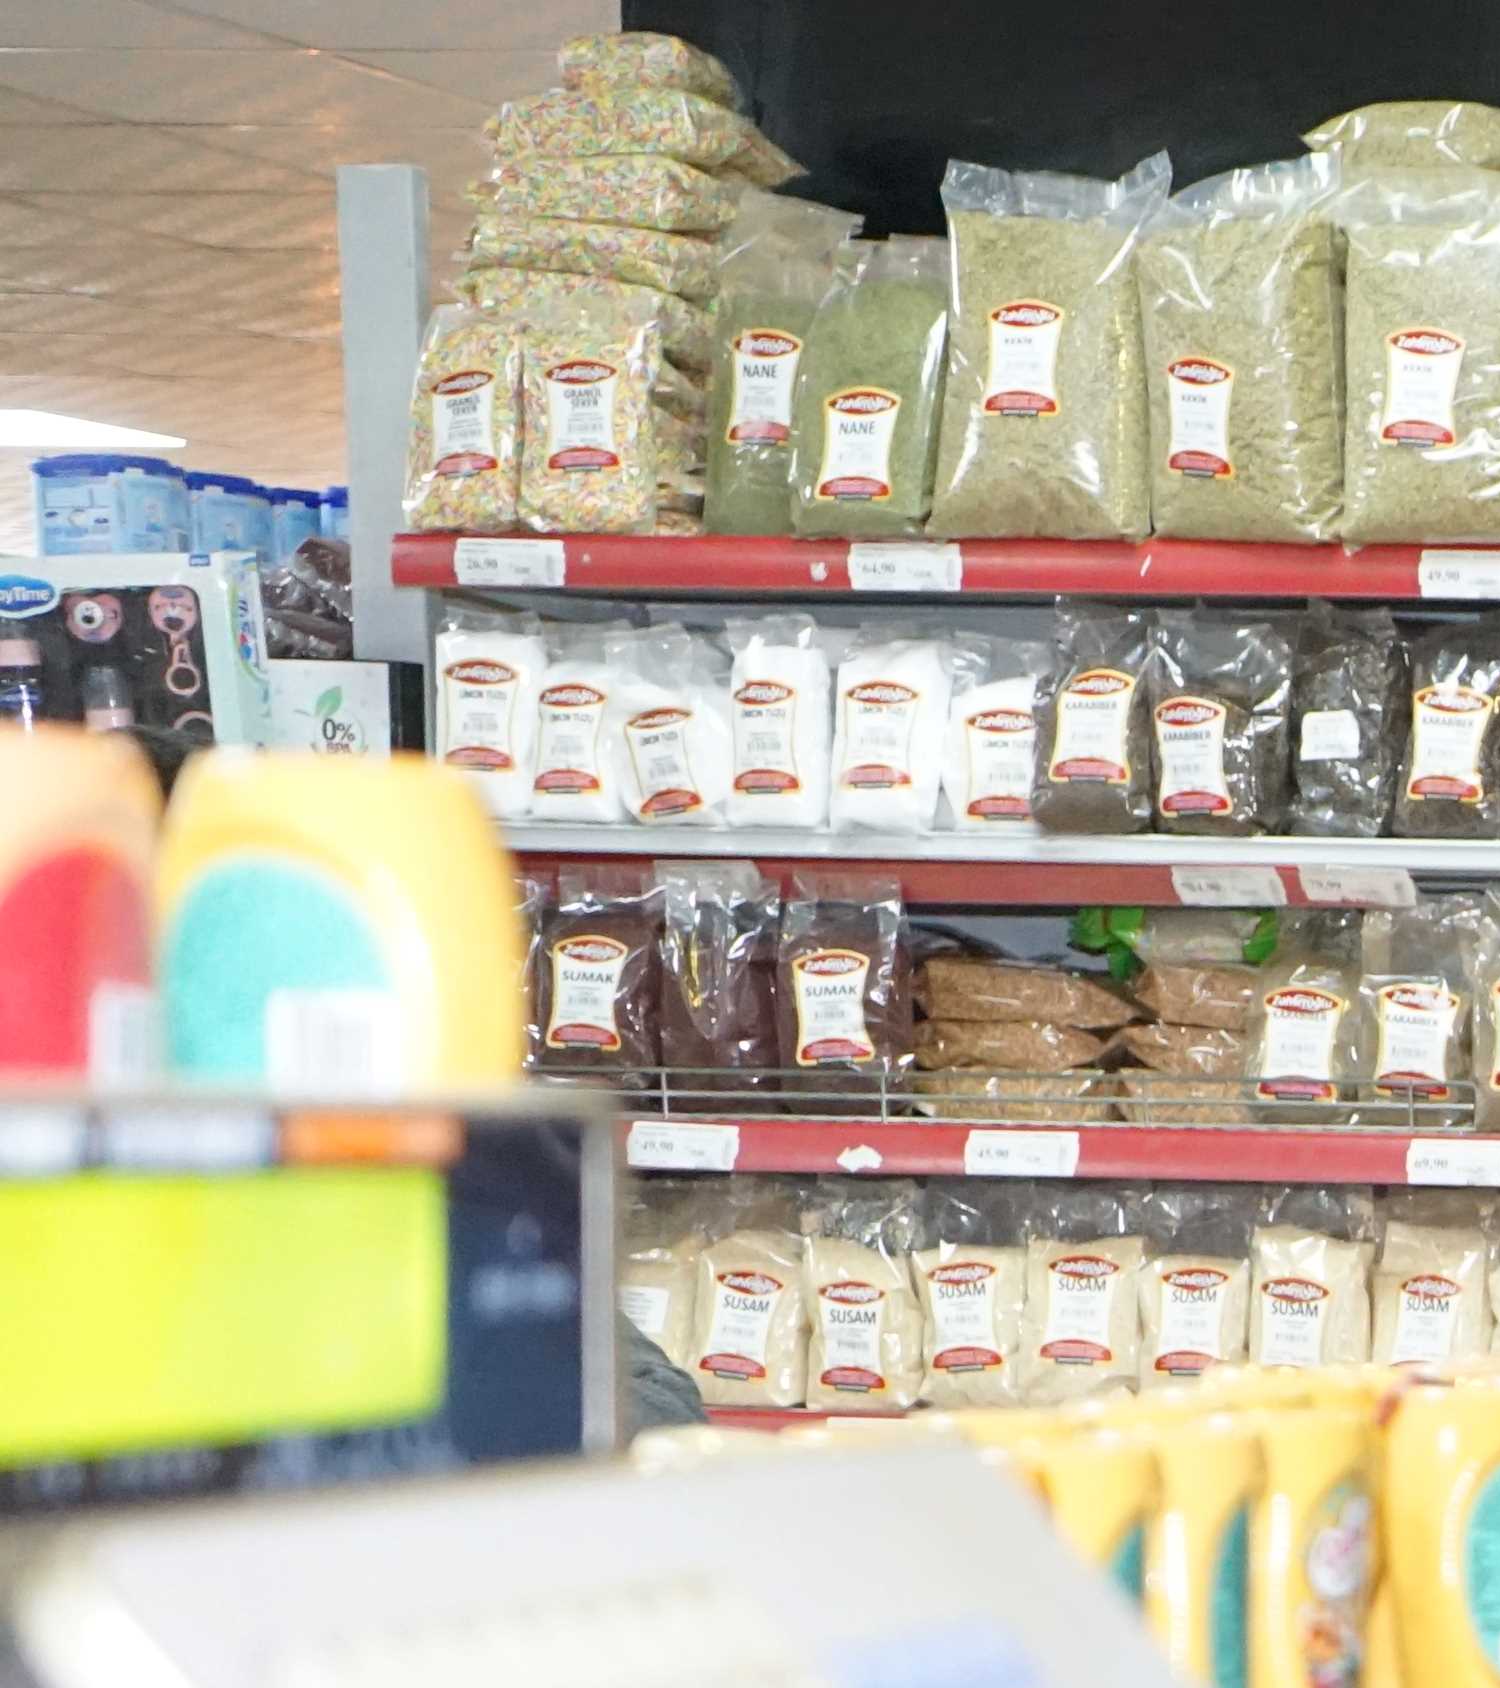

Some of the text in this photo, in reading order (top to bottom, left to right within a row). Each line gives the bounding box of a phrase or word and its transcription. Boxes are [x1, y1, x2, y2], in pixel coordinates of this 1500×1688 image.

[743, 364, 777, 378] NANE
[839, 421, 876, 435] NANE
[322, 718, 356, 742] 0%
[562, 969, 614, 984] SUMAK
[805, 984, 858, 997] SUMAK
[938, 1283, 986, 1299] SUSAM
[1059, 1278, 1107, 1292] SUSAM
[1172, 1288, 1217, 1303] SUSAM
[723, 1295, 770, 1312] SUSAM
[1271, 1302, 1318, 1317] SUSAM
[1405, 1297, 1449, 1312] SUSAM
[829, 1308, 876, 1324] SUSAM
